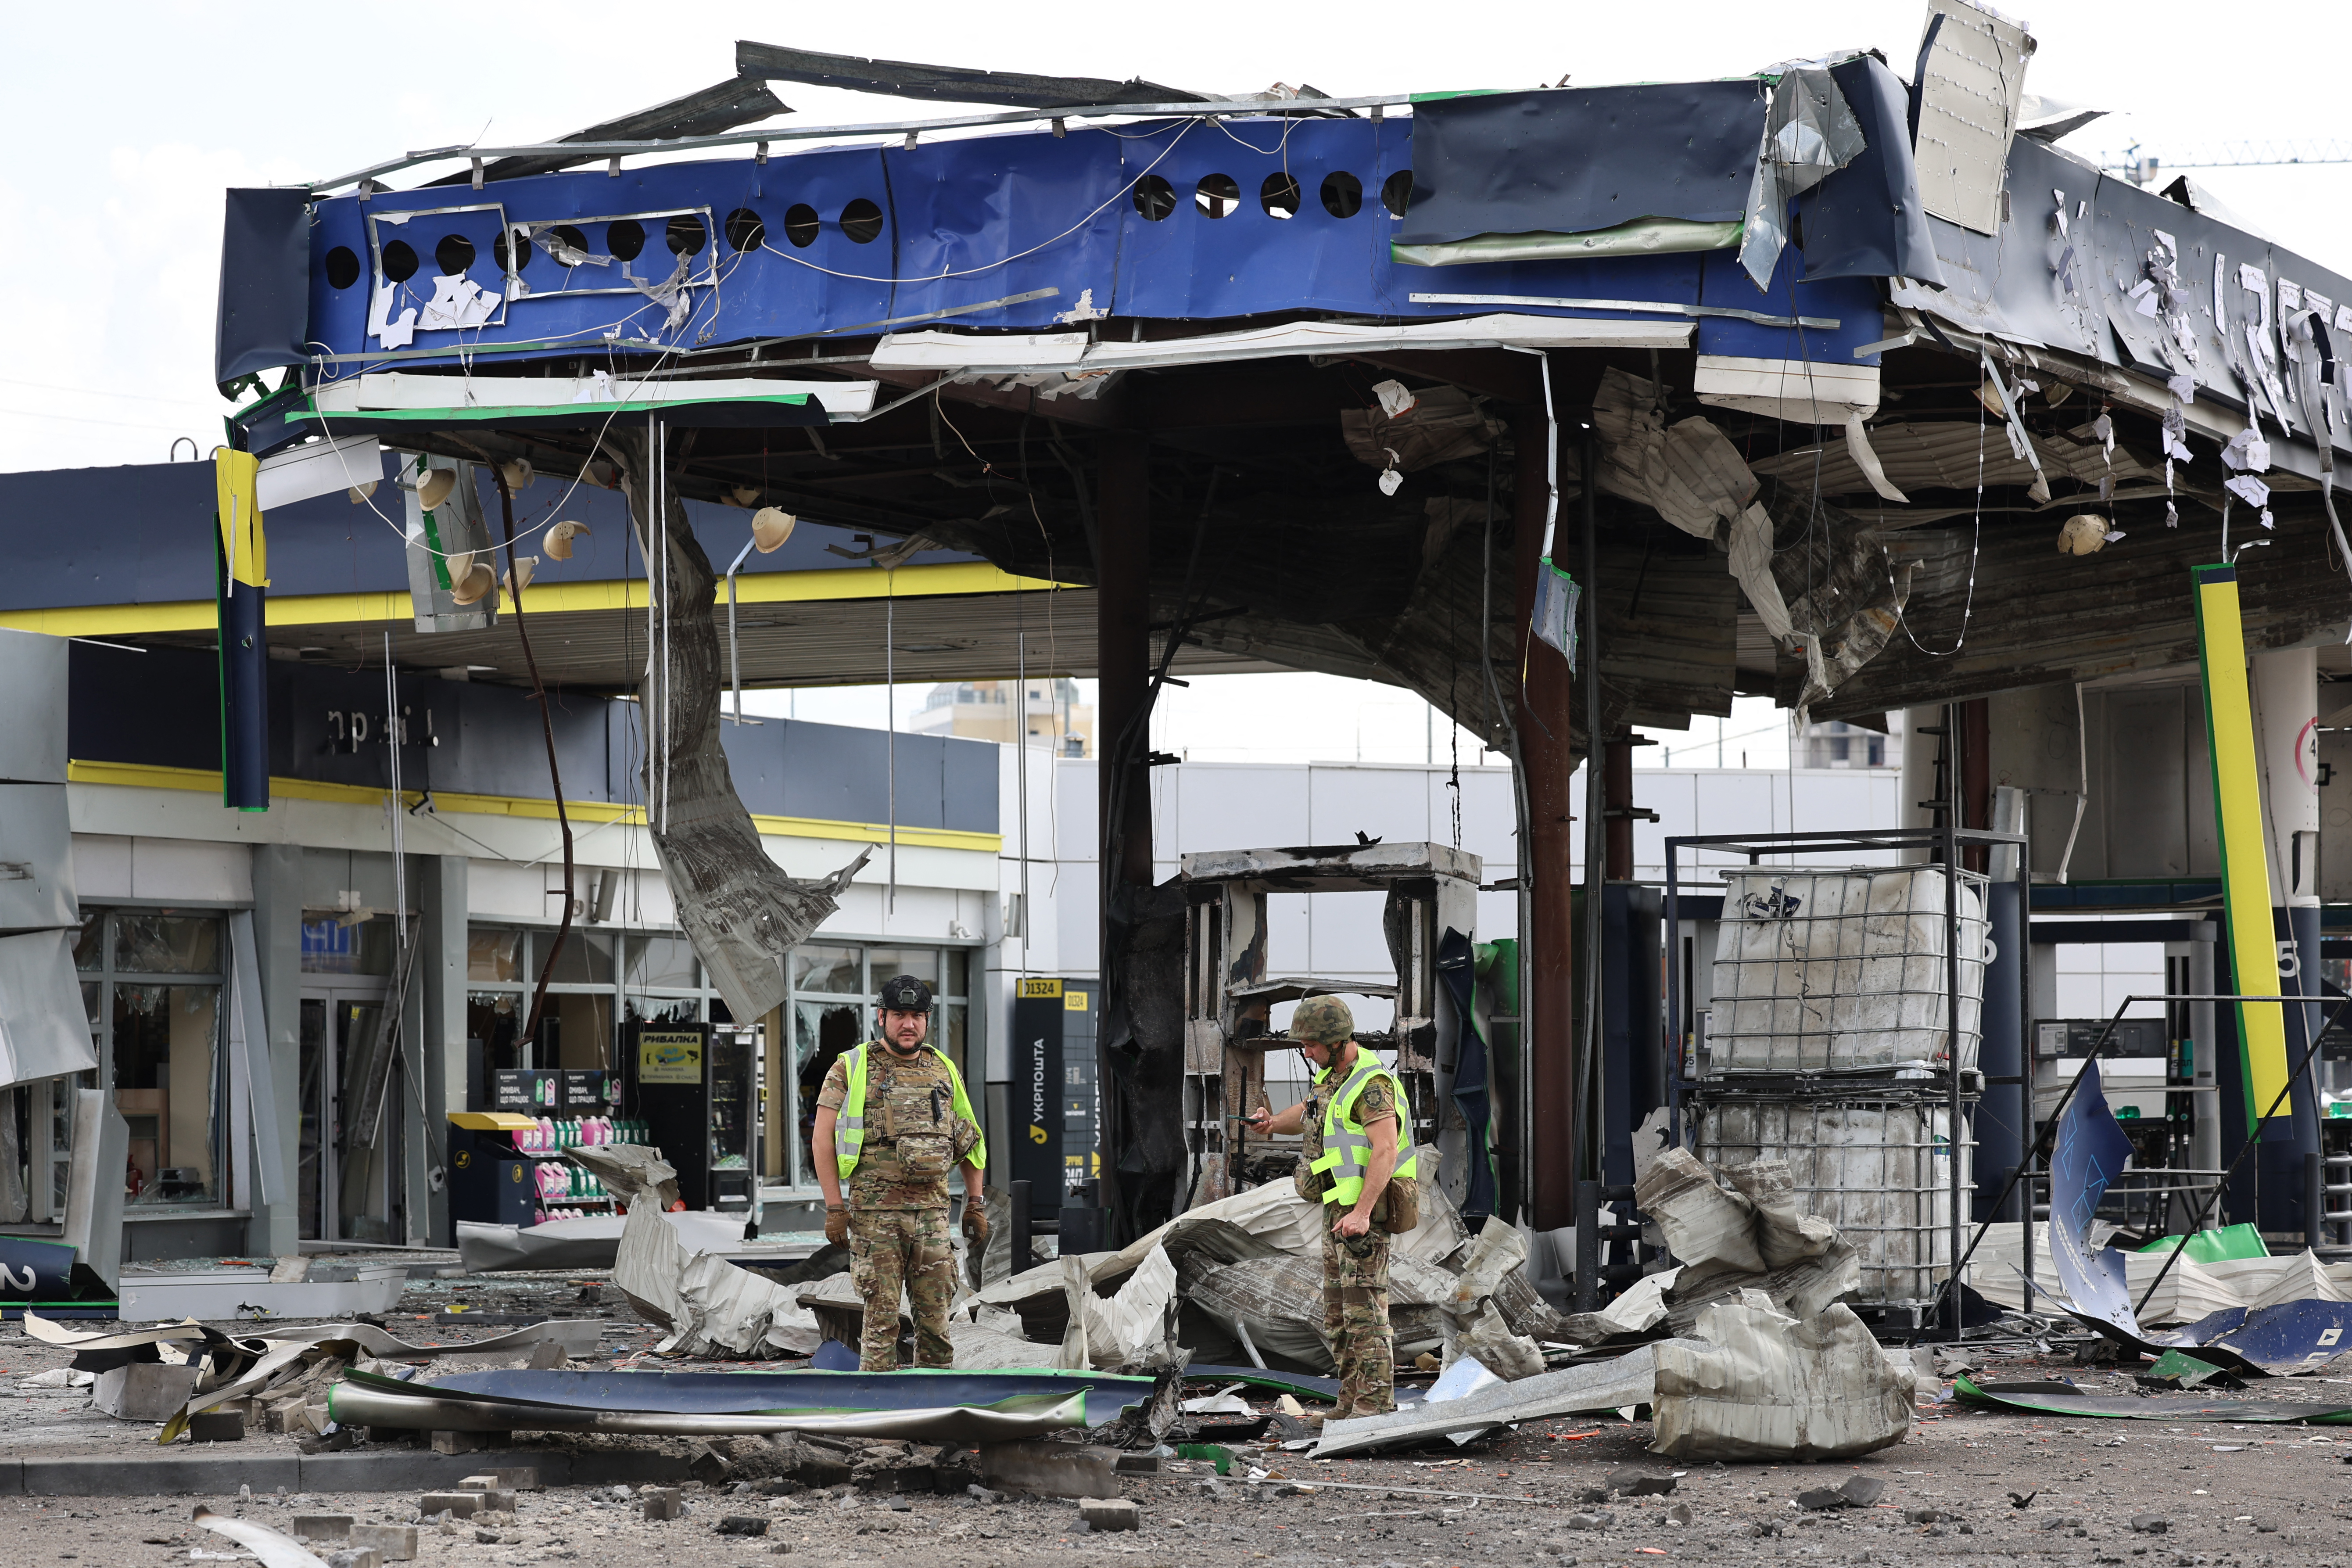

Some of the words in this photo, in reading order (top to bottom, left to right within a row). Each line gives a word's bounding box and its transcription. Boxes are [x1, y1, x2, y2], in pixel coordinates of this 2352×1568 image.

[2277, 940, 2301, 977] 5
[500, 1086, 521, 1094] ОМИВАЧ,
[569, 1086, 588, 1094] ОМИВАЧ,
[1033, 1038, 1044, 1123] УКРПОШТА
[0, 1263, 36, 1291] 2
